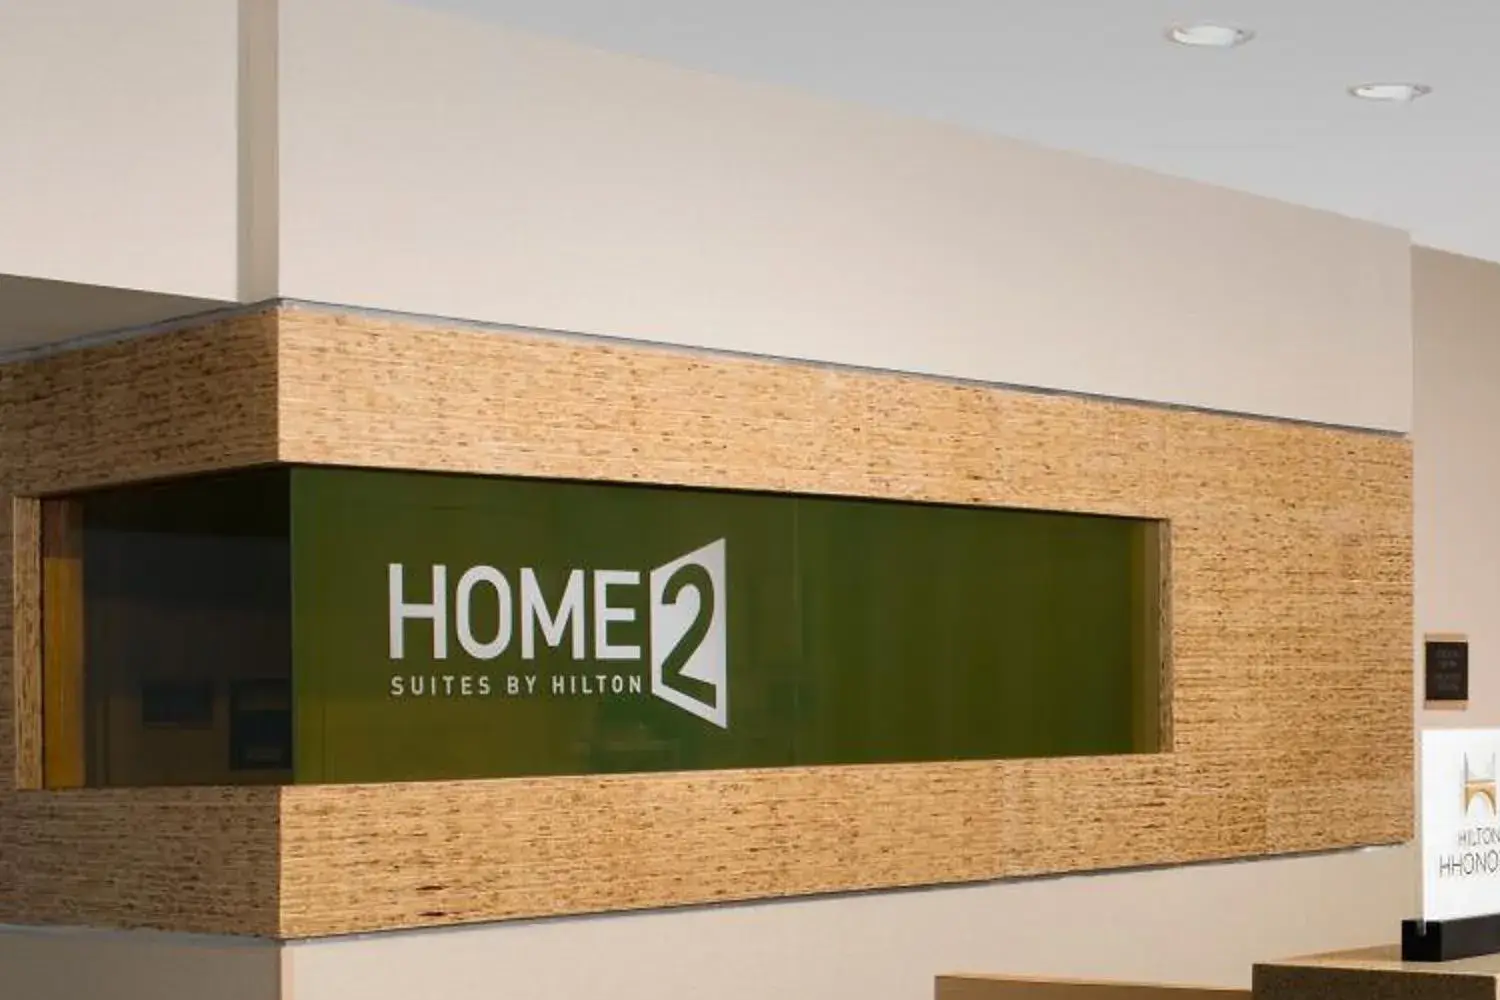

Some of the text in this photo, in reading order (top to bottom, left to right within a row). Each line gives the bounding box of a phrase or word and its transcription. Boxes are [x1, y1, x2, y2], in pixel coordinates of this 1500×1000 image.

[390, 675, 642, 696] SUITES BY HILTON
